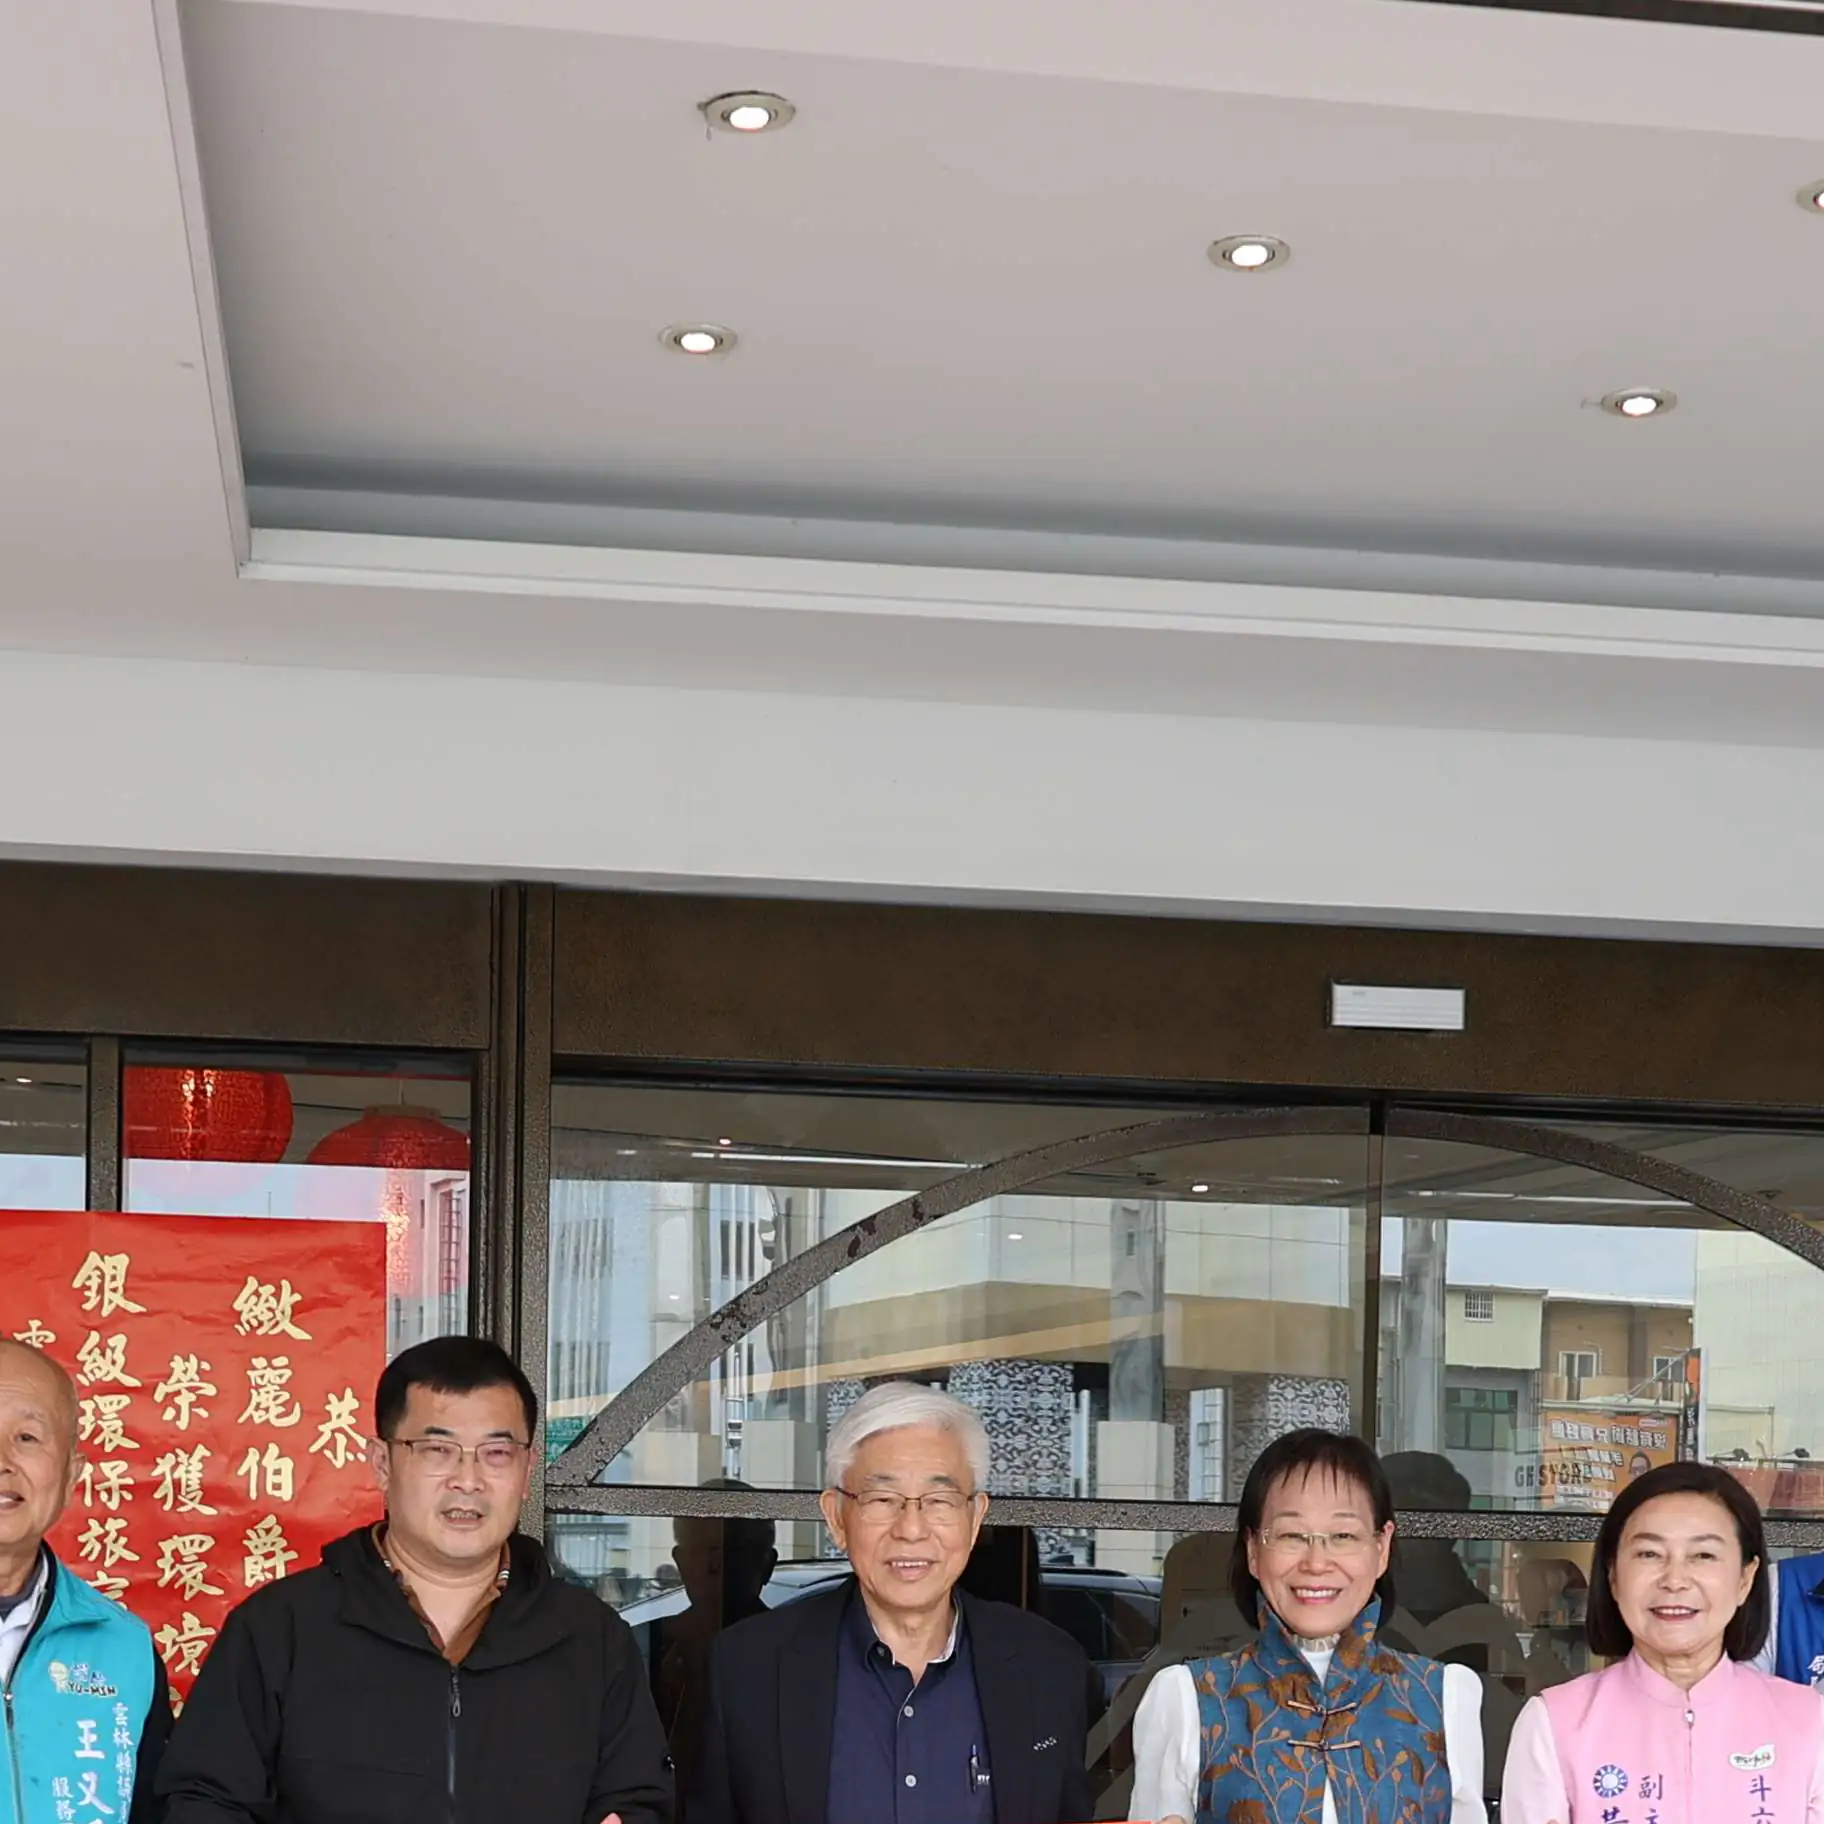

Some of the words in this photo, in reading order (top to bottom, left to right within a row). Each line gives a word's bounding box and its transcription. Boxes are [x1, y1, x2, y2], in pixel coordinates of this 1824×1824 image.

[151, 1354, 223, 1718] 榮獲環境
[233, 1276, 312, 1587] 緻麗伯爵
